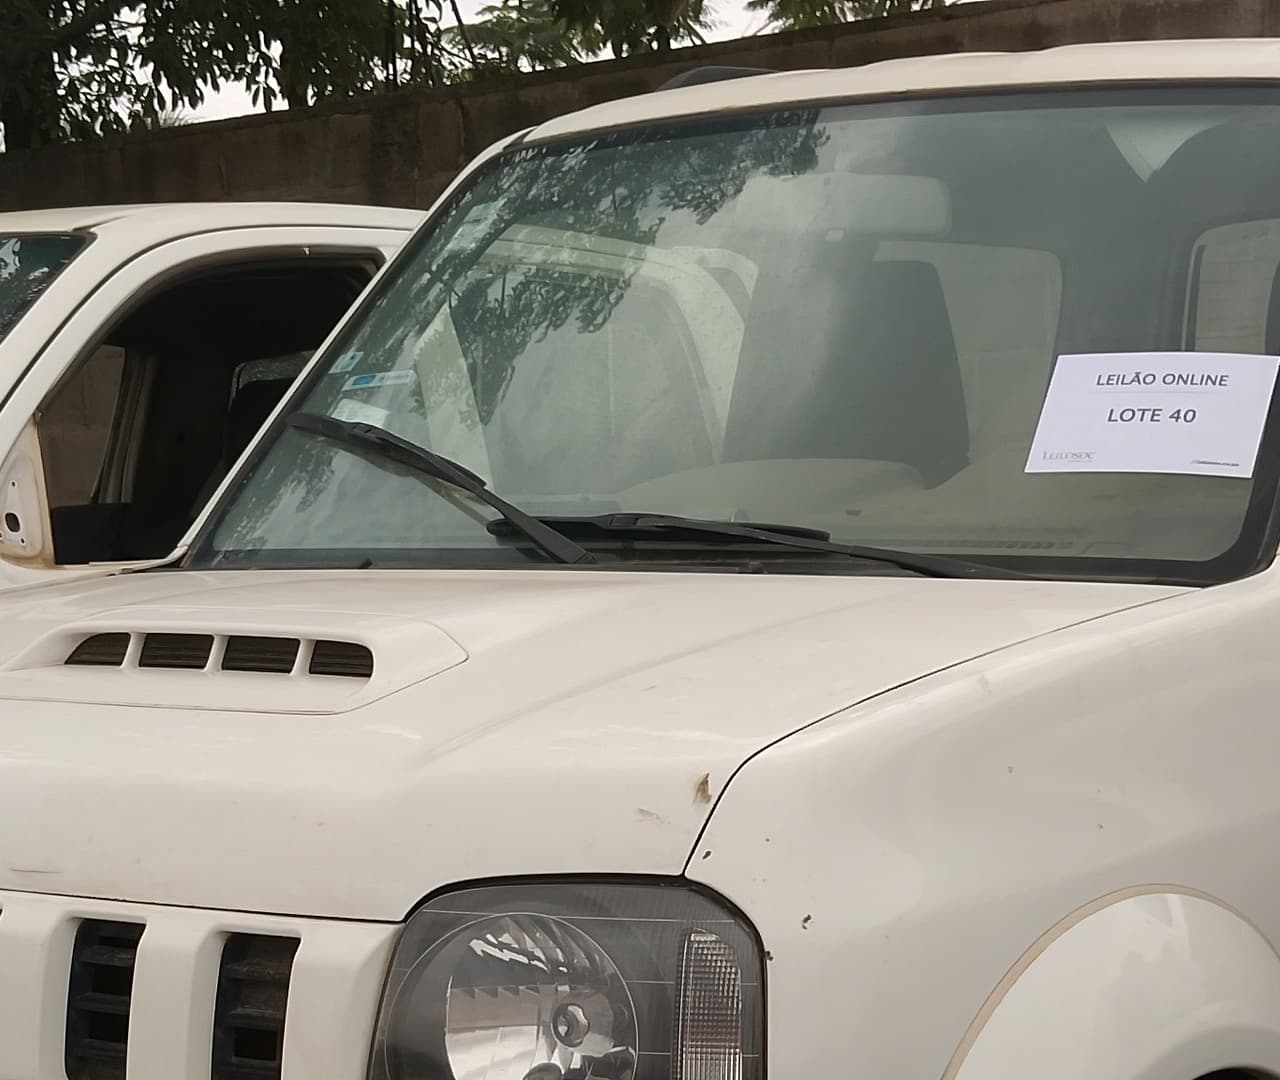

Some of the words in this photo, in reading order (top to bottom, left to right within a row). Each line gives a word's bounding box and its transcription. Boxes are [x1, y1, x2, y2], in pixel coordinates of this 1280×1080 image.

[1096, 371, 1157, 387] LEILÃO
[1162, 373, 1230, 387] ONLINE
[1107, 408, 1163, 423] LOTE
[1168, 408, 1197, 424] 40
